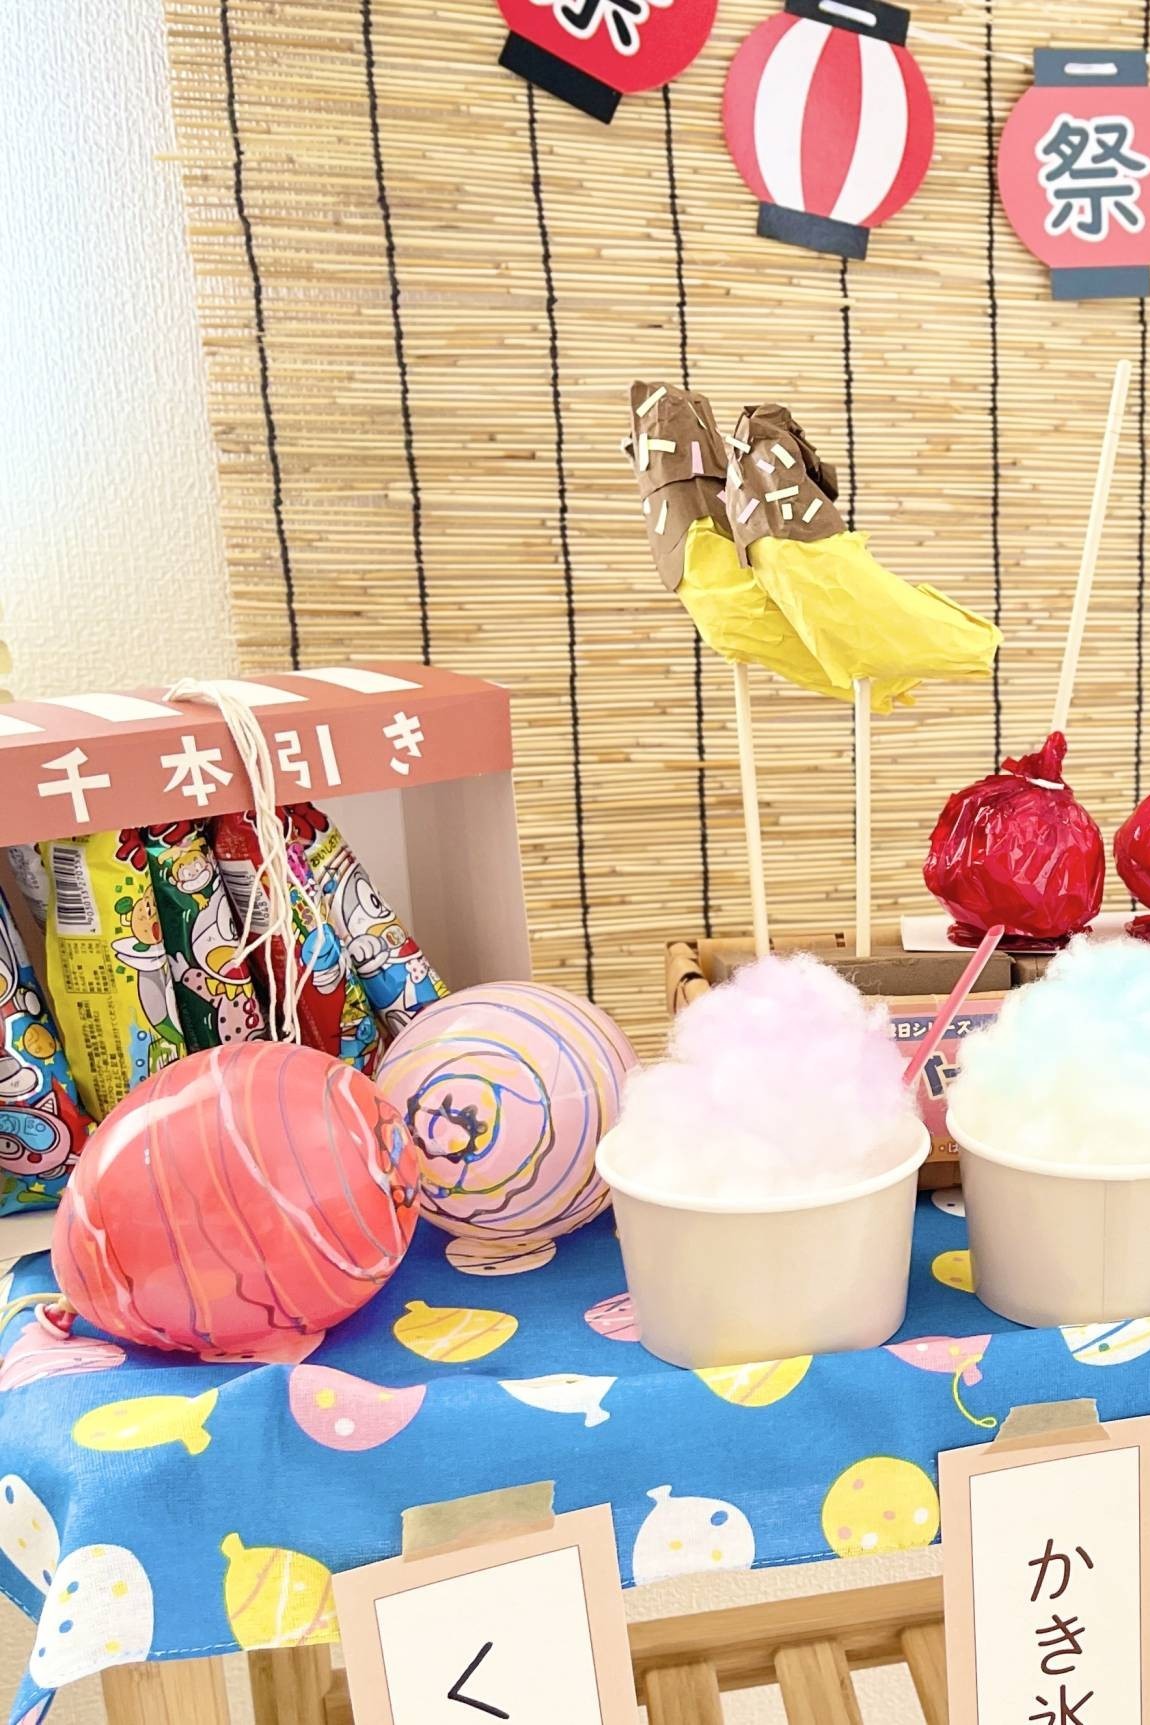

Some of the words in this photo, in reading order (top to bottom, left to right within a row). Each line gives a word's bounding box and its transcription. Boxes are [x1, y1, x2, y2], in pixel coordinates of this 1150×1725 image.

[1038, 117, 1149, 238] 祭
[37, 711, 425, 823] 千本引き
[446, 1641, 511, 1720] く
[1025, 1537, 1096, 1725] かき氷
